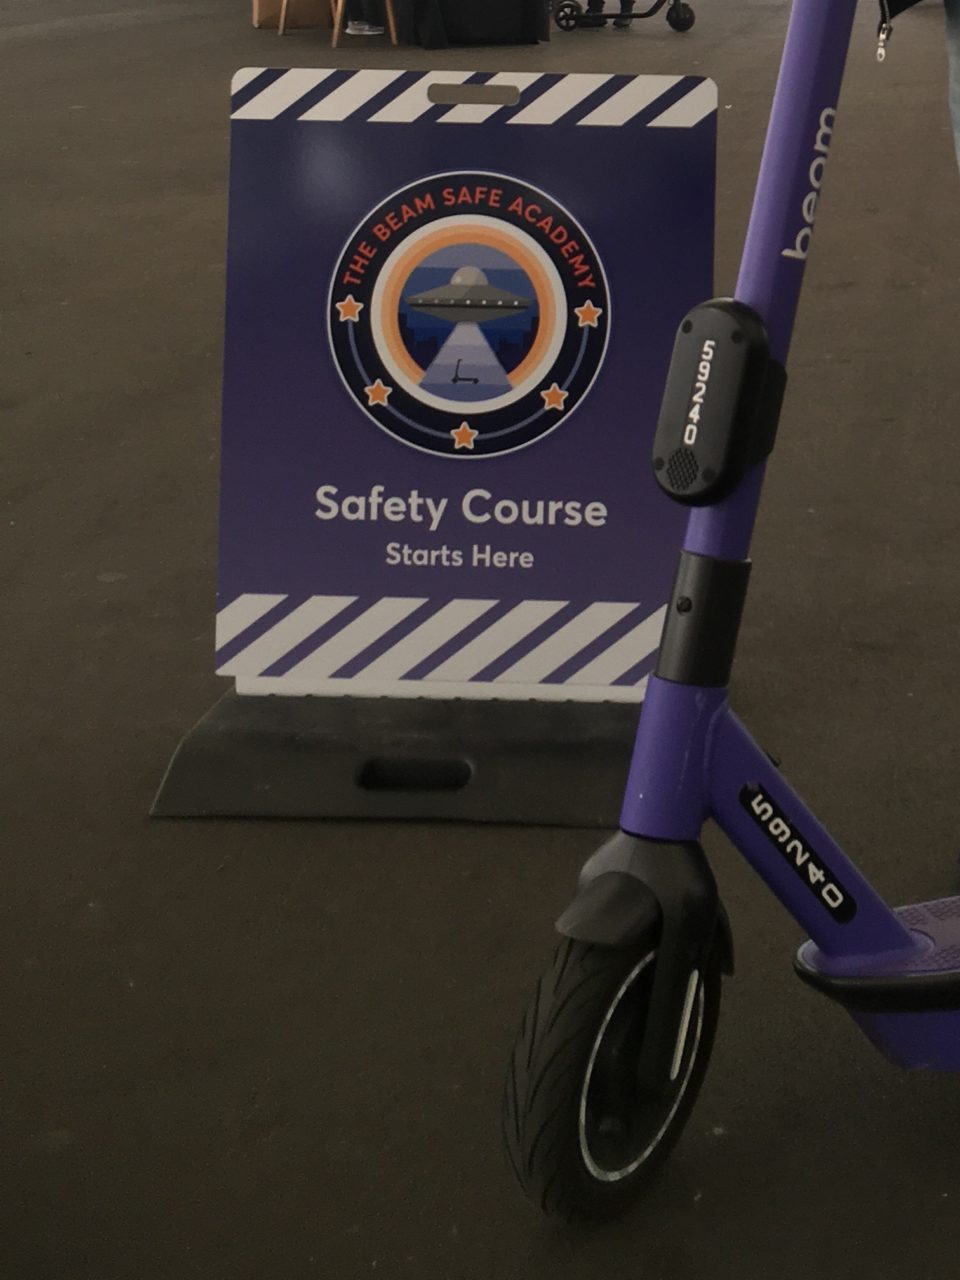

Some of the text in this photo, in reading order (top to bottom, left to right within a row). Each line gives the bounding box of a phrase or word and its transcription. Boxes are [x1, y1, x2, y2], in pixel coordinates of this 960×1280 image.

[343, 186, 597, 289] THE BEAM SAFE ACADEMY
[684, 340, 715, 445] 59240
[315, 484, 608, 531] Safety Course
[385, 542, 535, 568] Starts Here
[751, 794, 844, 908] 59240
